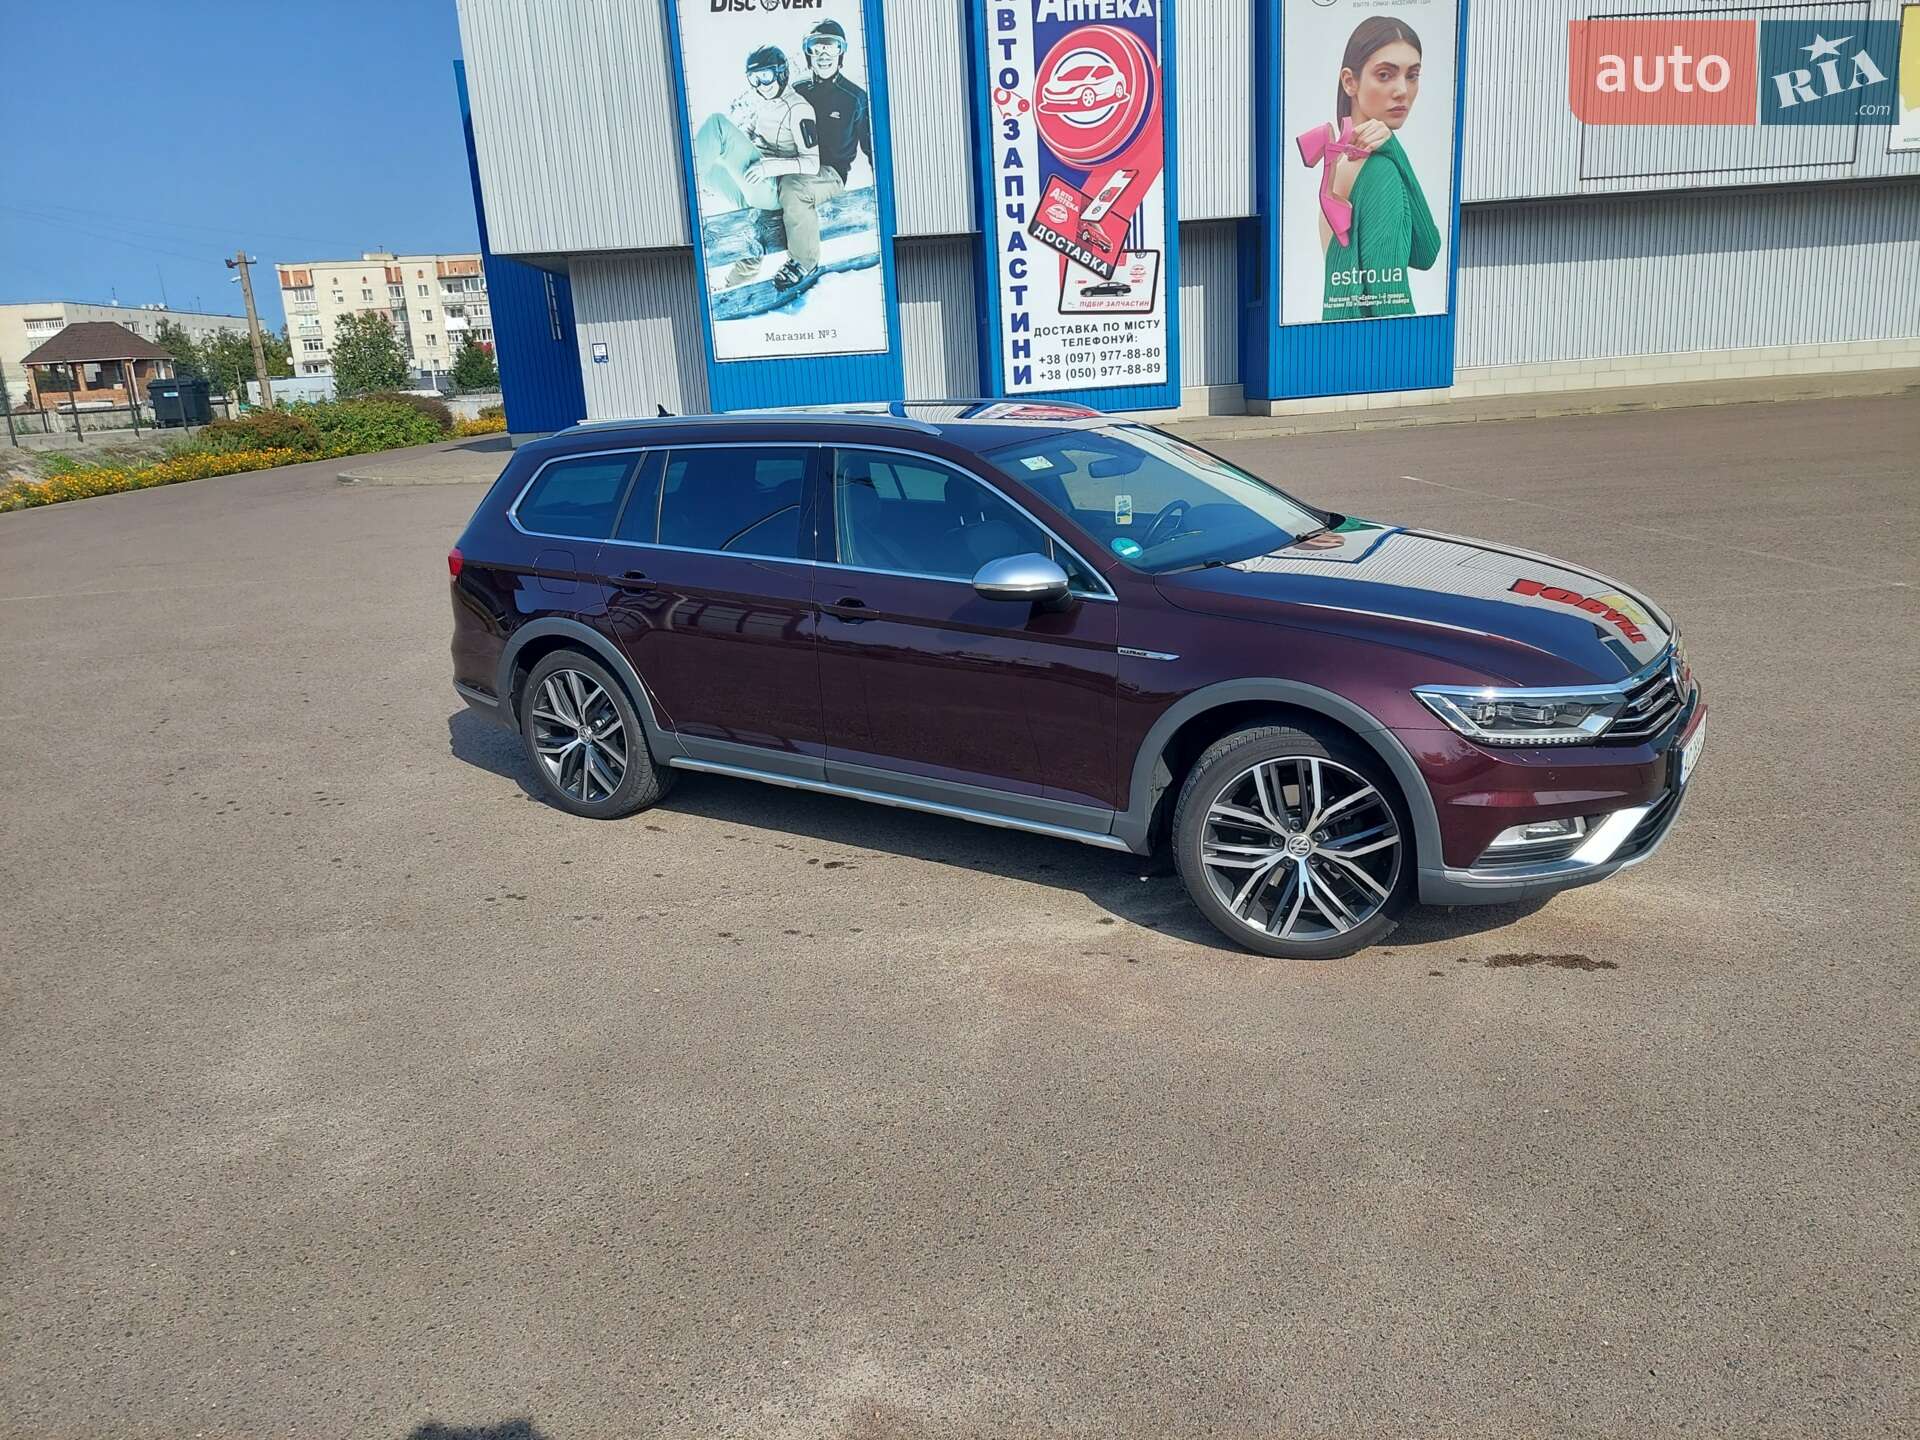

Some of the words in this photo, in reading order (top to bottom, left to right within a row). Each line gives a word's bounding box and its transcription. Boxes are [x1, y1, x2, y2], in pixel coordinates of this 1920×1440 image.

[1034, 223, 1107, 276] ДОСТАВКА
[1331, 267, 1402, 285] estro.ua
[765, 332, 816, 342] Магазин
[1034, 324, 1098, 338] ДОСТАВКА
[1103, 322, 1120, 332] ПО
[1124, 319, 1161, 330] МІСТУ
[1061, 333, 1139, 347] ТЕЛЕФОНУЙ:
[1039, 354, 1061, 365] +38
[1065, 351, 1096, 366] (097)
[1100, 347, 1161, 361] 977-88-80
[1040, 369, 1061, 380] +38
[1066, 367, 1097, 381] (050)
[1100, 362, 1161, 377] 977-88-89
